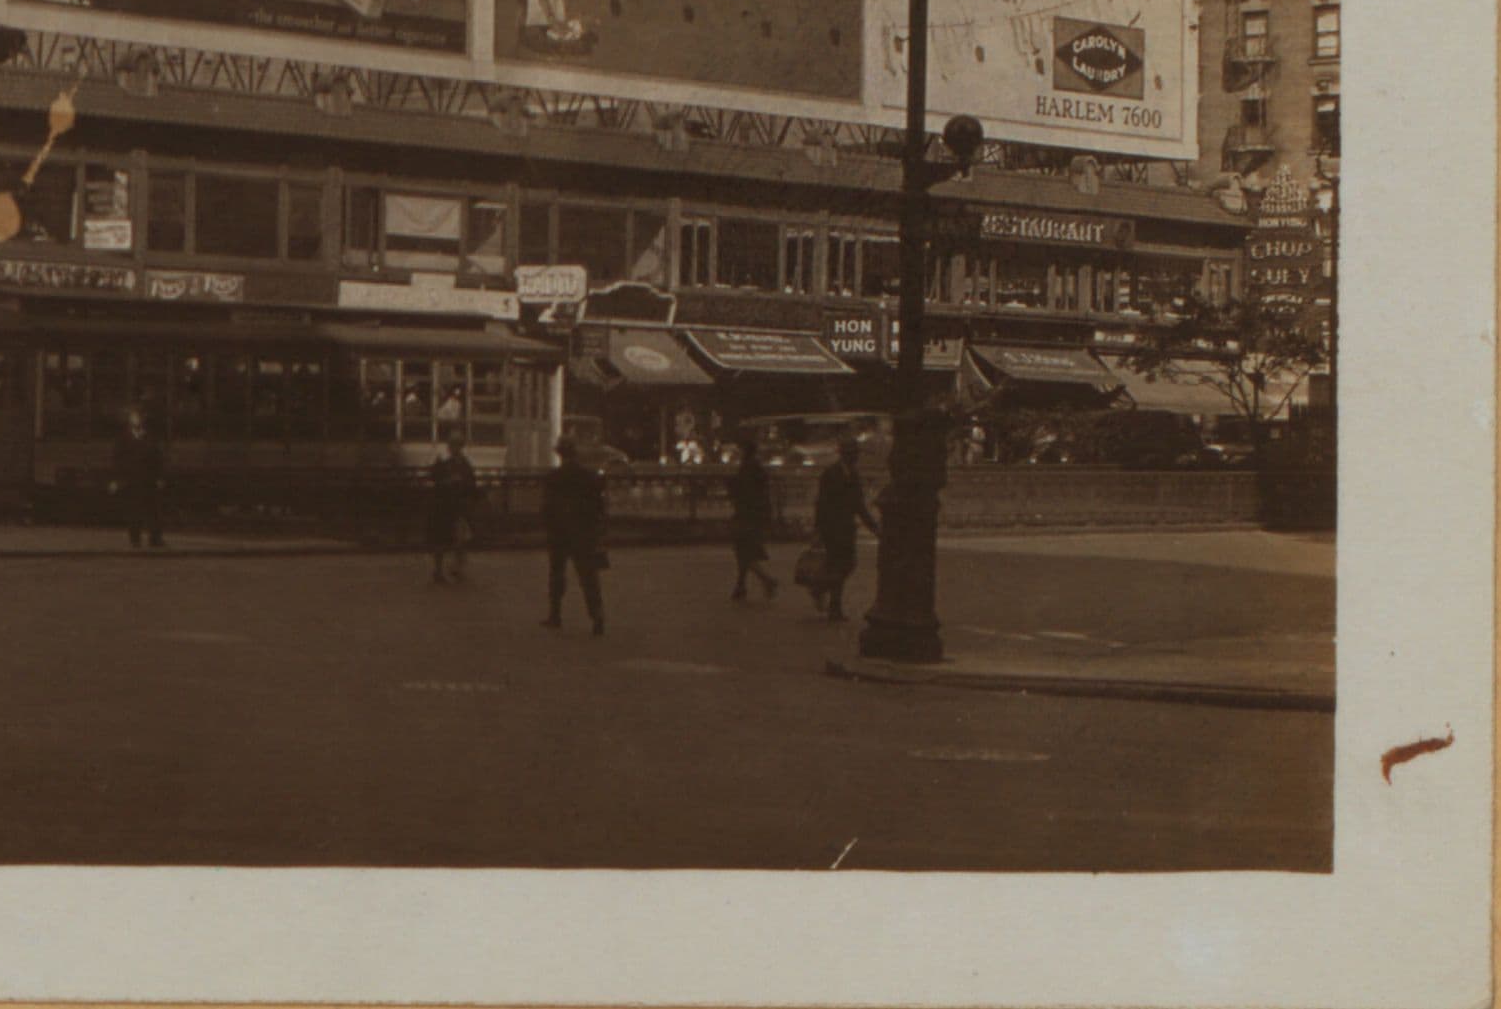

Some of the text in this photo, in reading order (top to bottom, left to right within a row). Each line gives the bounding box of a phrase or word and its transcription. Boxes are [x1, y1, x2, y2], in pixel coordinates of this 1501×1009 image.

[1071, 35, 1127, 60] CAROLYN
[1071, 55, 1127, 83] LAUNDRY
[1035, 94, 1163, 130] HARLEM 7600
[980, 214, 1105, 243] RESTAURANT
[1250, 266, 1311, 285] SUEY
[834, 319, 872, 334] HON
[830, 339, 876, 353] YUNG
